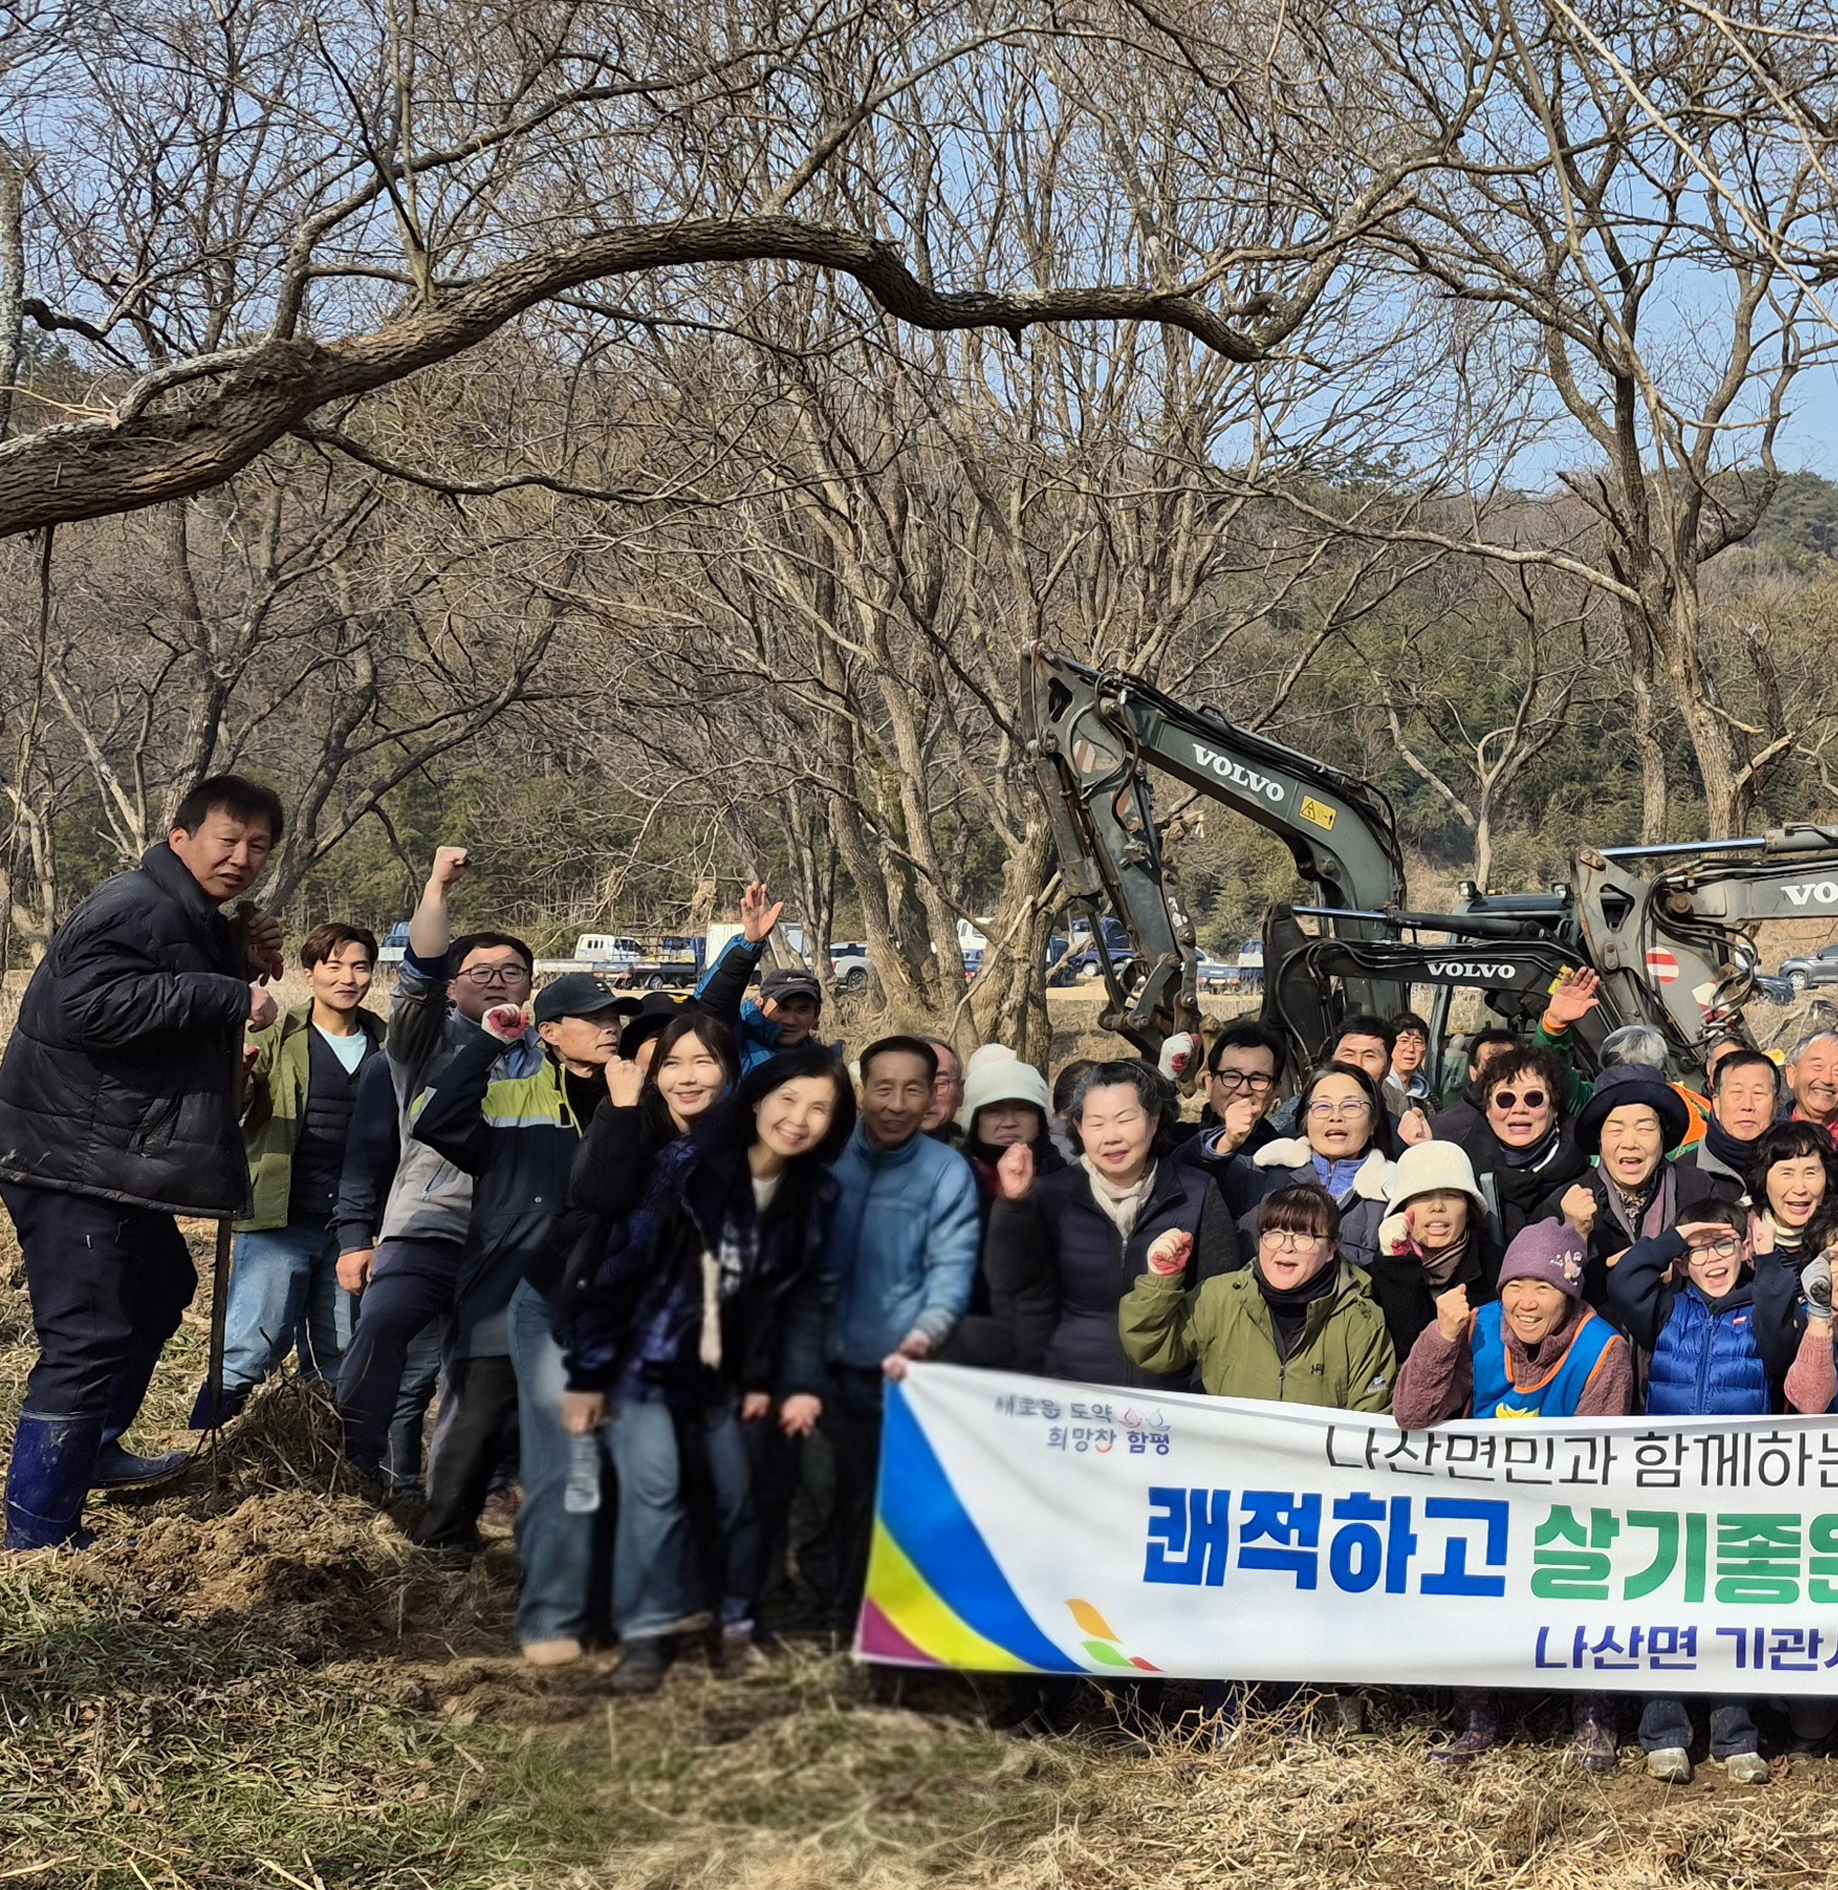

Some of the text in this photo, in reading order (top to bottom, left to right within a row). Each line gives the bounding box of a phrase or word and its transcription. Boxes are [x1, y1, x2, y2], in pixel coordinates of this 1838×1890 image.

[1193, 743, 1284, 801] VOLVO
[1427, 962, 1516, 979] VOLVO
[1070, 1403, 1113, 1423] 도약
[1047, 1427, 1170, 1456] 희망찬 함평
[1326, 1424, 1617, 1485] 나산면민과
[1143, 1487, 1510, 1597] 쾌적하고
[1535, 1625, 1697, 1670] 나산면
